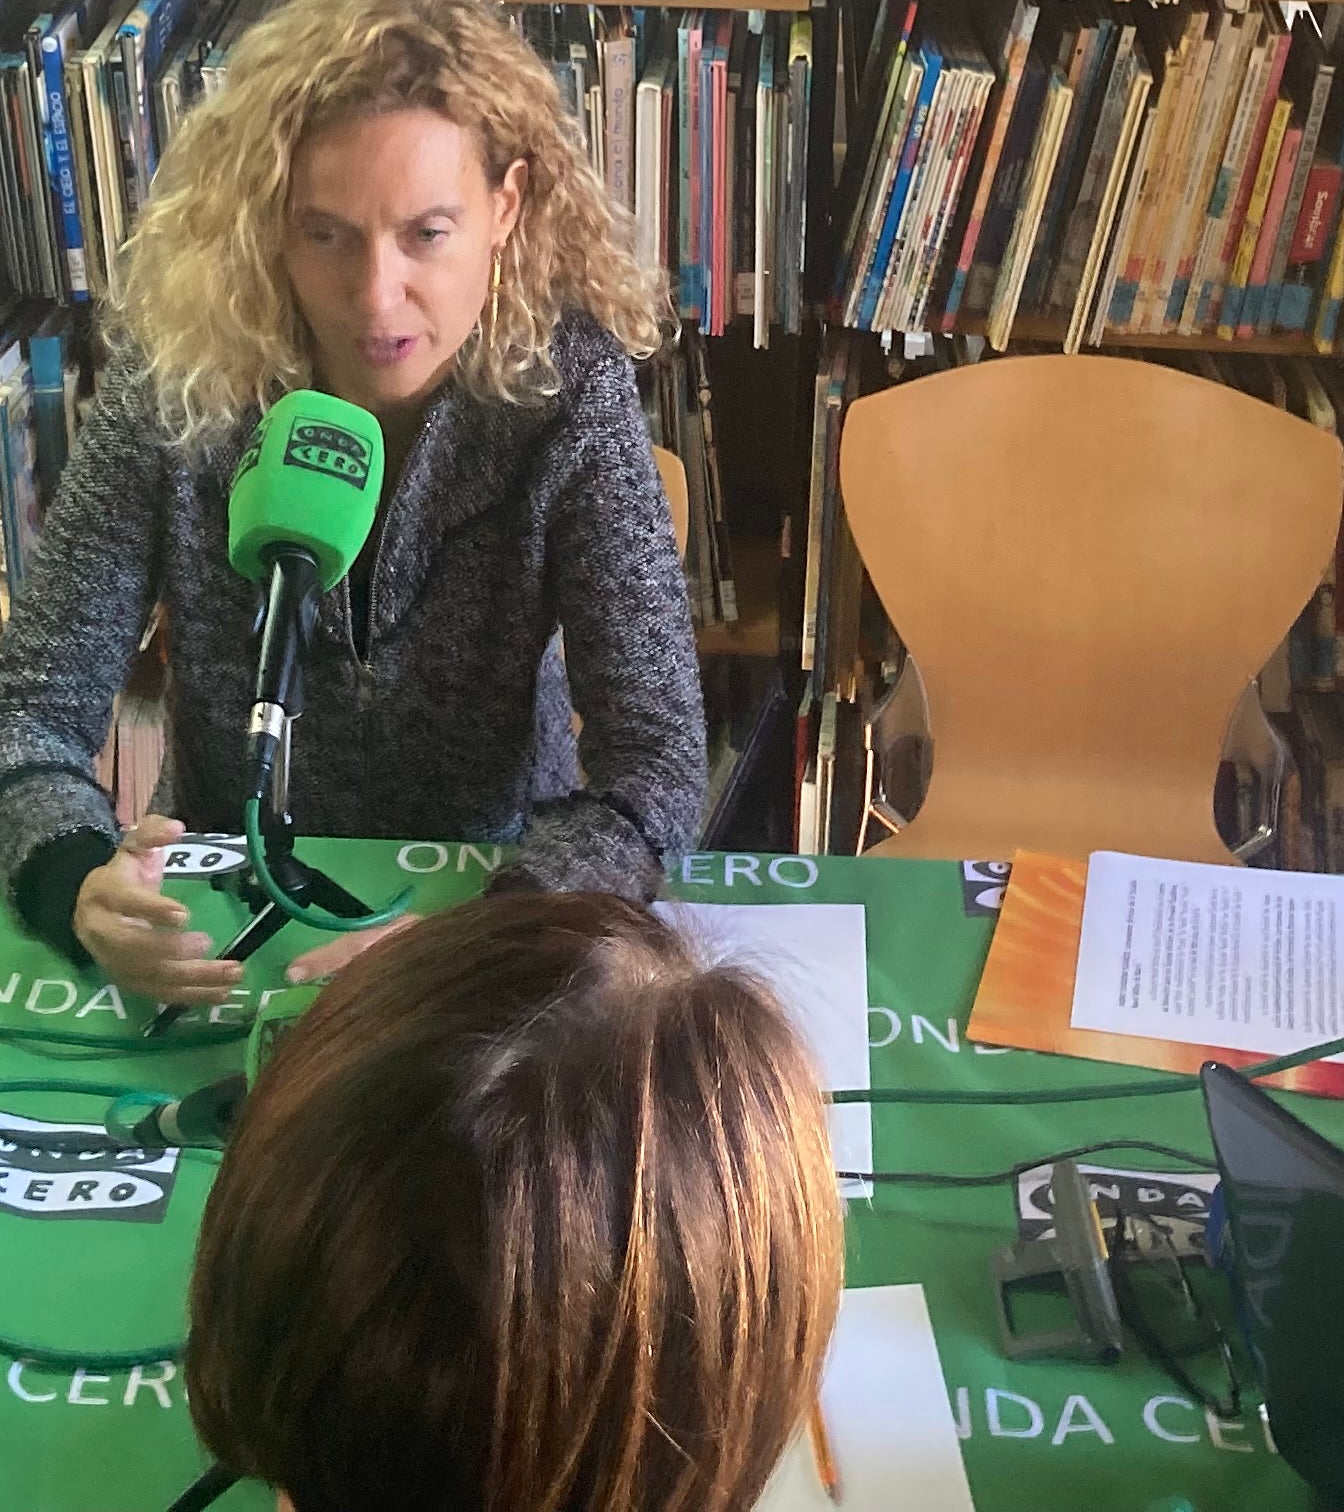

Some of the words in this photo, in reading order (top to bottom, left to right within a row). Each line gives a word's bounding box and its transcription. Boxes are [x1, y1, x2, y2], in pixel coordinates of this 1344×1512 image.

[1302, 189, 1330, 250] Sombras
[301, 446, 358, 475] CERO
[664, 853, 820, 889] ERO
[1047, 1183, 1206, 1208] NDA
[8, 1354, 188, 1409] CER
